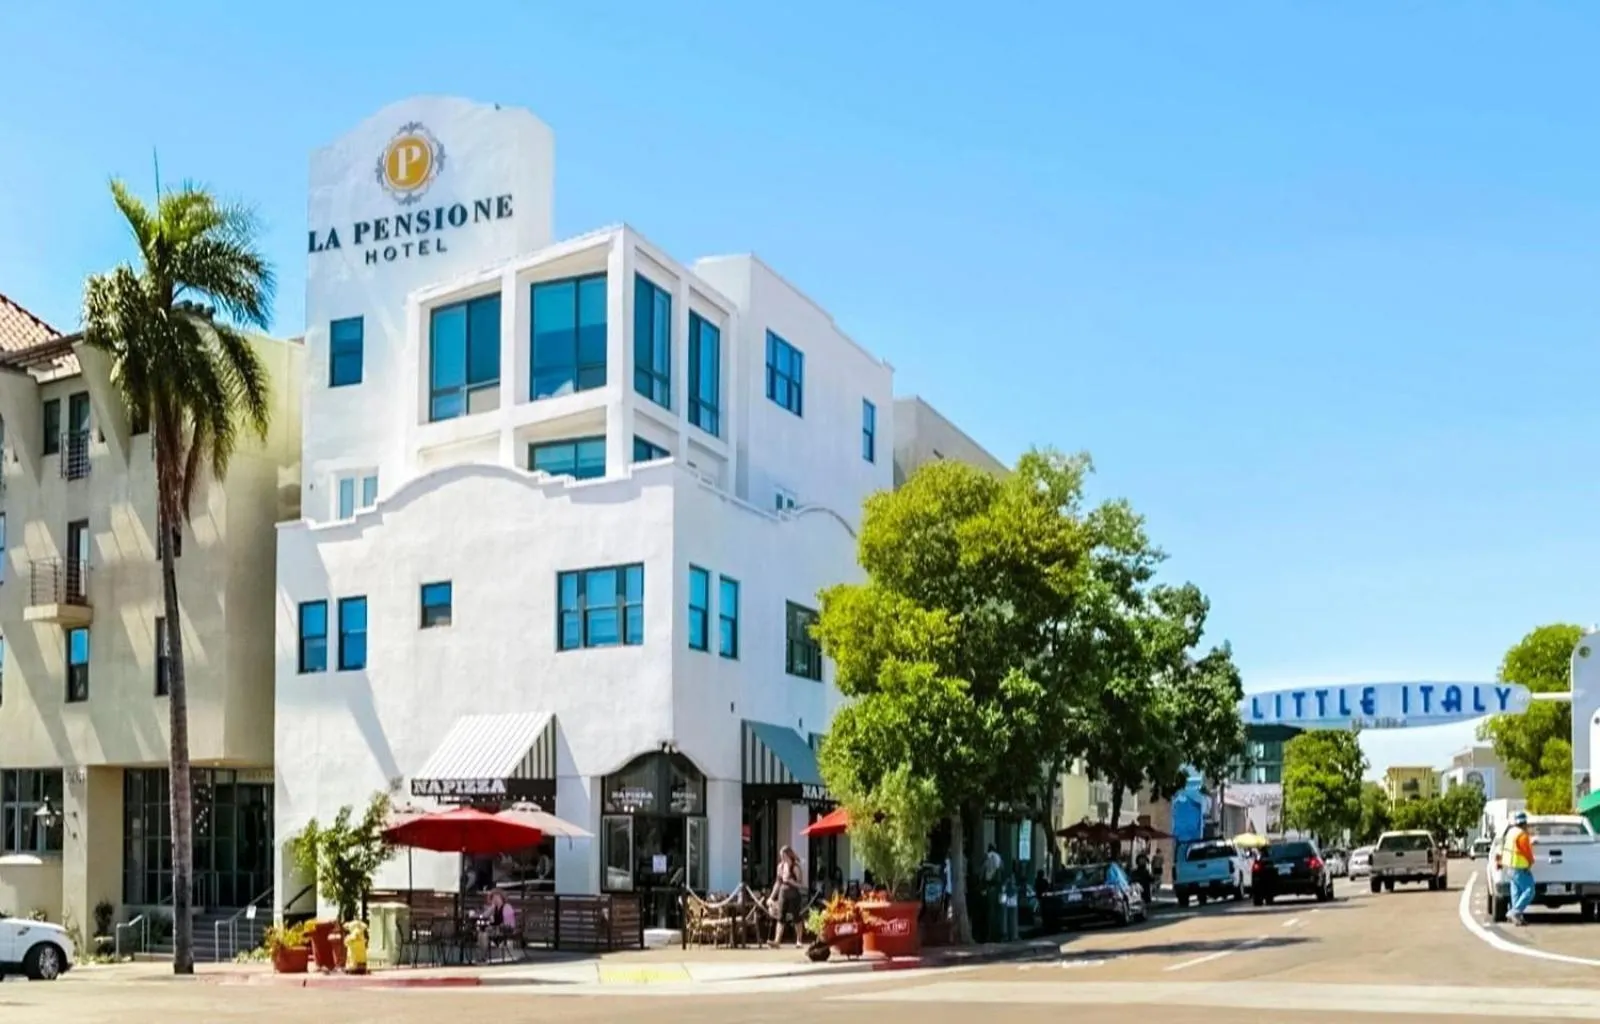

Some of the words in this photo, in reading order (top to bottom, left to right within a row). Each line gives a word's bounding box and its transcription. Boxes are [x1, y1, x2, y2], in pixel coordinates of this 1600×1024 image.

[395, 144, 422, 181] P
[307, 227, 342, 253] LA
[353, 194, 514, 245] PENSIONE
[365, 237, 448, 265] HOTEL
[1252, 686, 1375, 719] LITTLE
[1402, 685, 1512, 714] ITALY
[412, 780, 506, 794] NAPIZZA
[802, 784, 841, 800] NAPI
